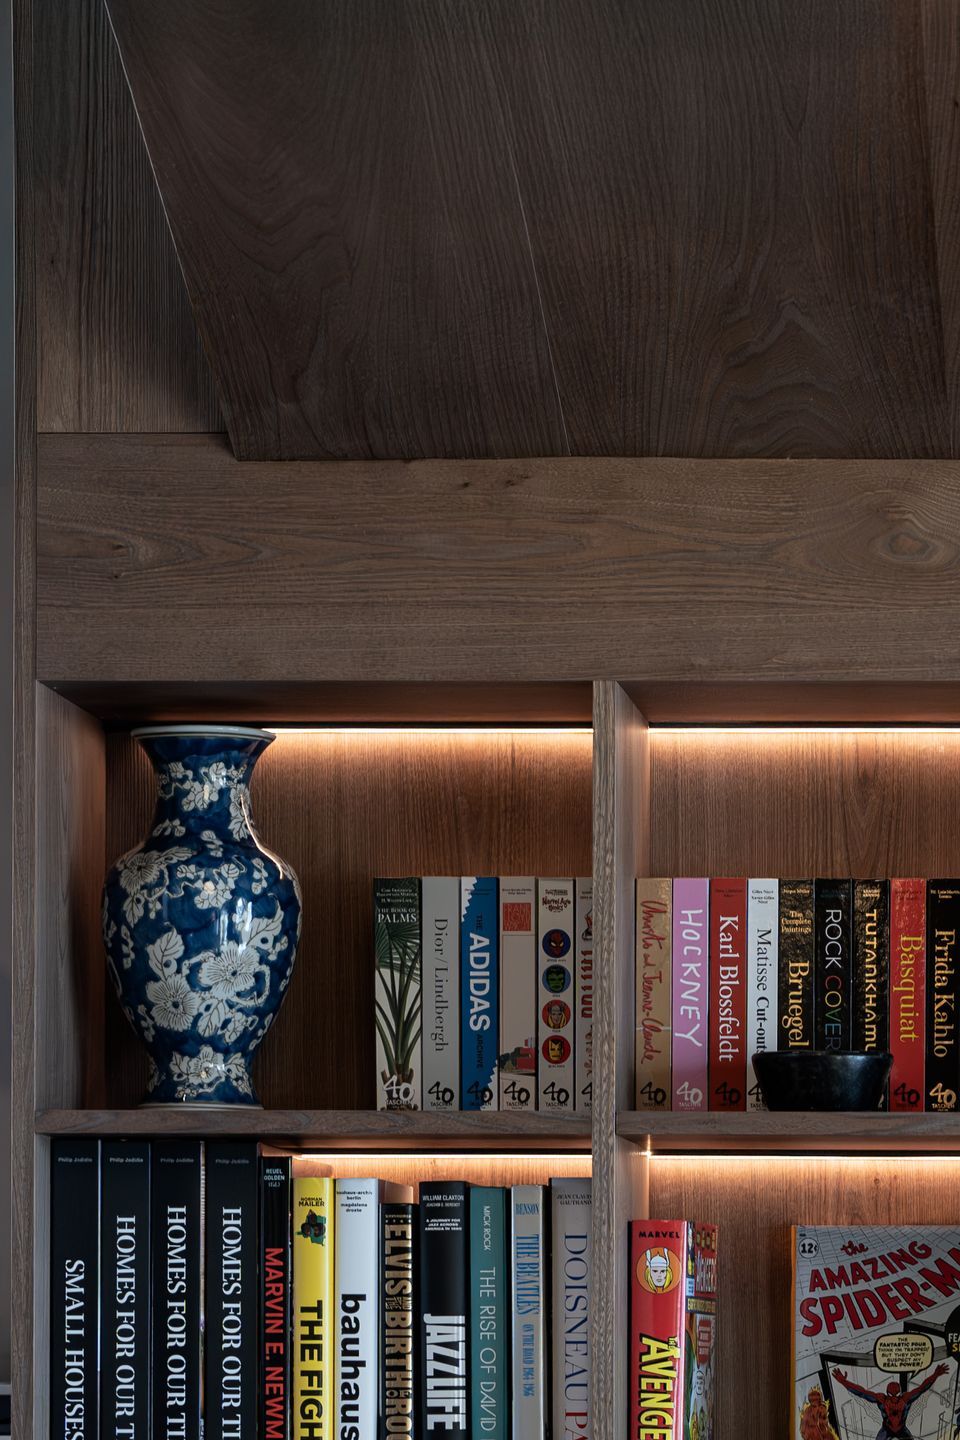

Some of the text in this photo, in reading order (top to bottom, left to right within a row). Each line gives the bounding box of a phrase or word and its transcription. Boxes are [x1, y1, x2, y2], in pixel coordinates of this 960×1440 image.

[377, 913, 417, 924] PALMS
[825, 909, 842, 968] ROCK
[469, 933, 490, 1031] ADIDAS
[675, 909, 703, 1047] HOCKNEY
[756, 929, 771, 991] Matisse
[718, 915, 740, 1062] Karl Blossfeldt
[782, 961, 809, 1047] Bruegel
[892, 935, 922, 1042] Basquiat
[934, 929, 955, 1058] Frida Kahlo
[429, 1081, 456, 1103] 40
[676, 1081, 704, 1104] 40
[929, 1082, 957, 1104] 40
[298, 1200, 325, 1208] MAILER
[483, 1206, 492, 1251] MICK ROCK
[115, 1215, 136, 1304] HOMES
[166, 1205, 187, 1294] HOMES
[221, 1206, 242, 1295] HOMES
[385, 1225, 412, 1294] ELVIS
[639, 1231, 681, 1239] MARVEL
[841, 1240, 868, 1256] the
[265, 1248, 284, 1335] MARVIN
[480, 1267, 495, 1298] THE
[516, 1234, 540, 1315] THE BEATLES
[809, 1240, 933, 1293] AMAZING
[64, 1259, 85, 1343] SMALL
[166, 1300, 186, 1349] FOR
[221, 1301, 241, 1350] FOR
[480, 1305, 495, 1340] RISE
[564, 1234, 588, 1402] DOISNEAU
[115, 1310, 135, 1358] FOR
[265, 1342, 283, 1361] E.
[301, 1300, 323, 1363] THE
[385, 1312, 413, 1391] BIRTH
[166, 1354, 186, 1408] OUR
[221, 1356, 241, 1409] OUR
[423, 1314, 467, 1430] JAZZLIFE
[479, 1347, 496, 1374] OF
[115, 1364, 135, 1418] OUR
[480, 1381, 495, 1431] DAVID
